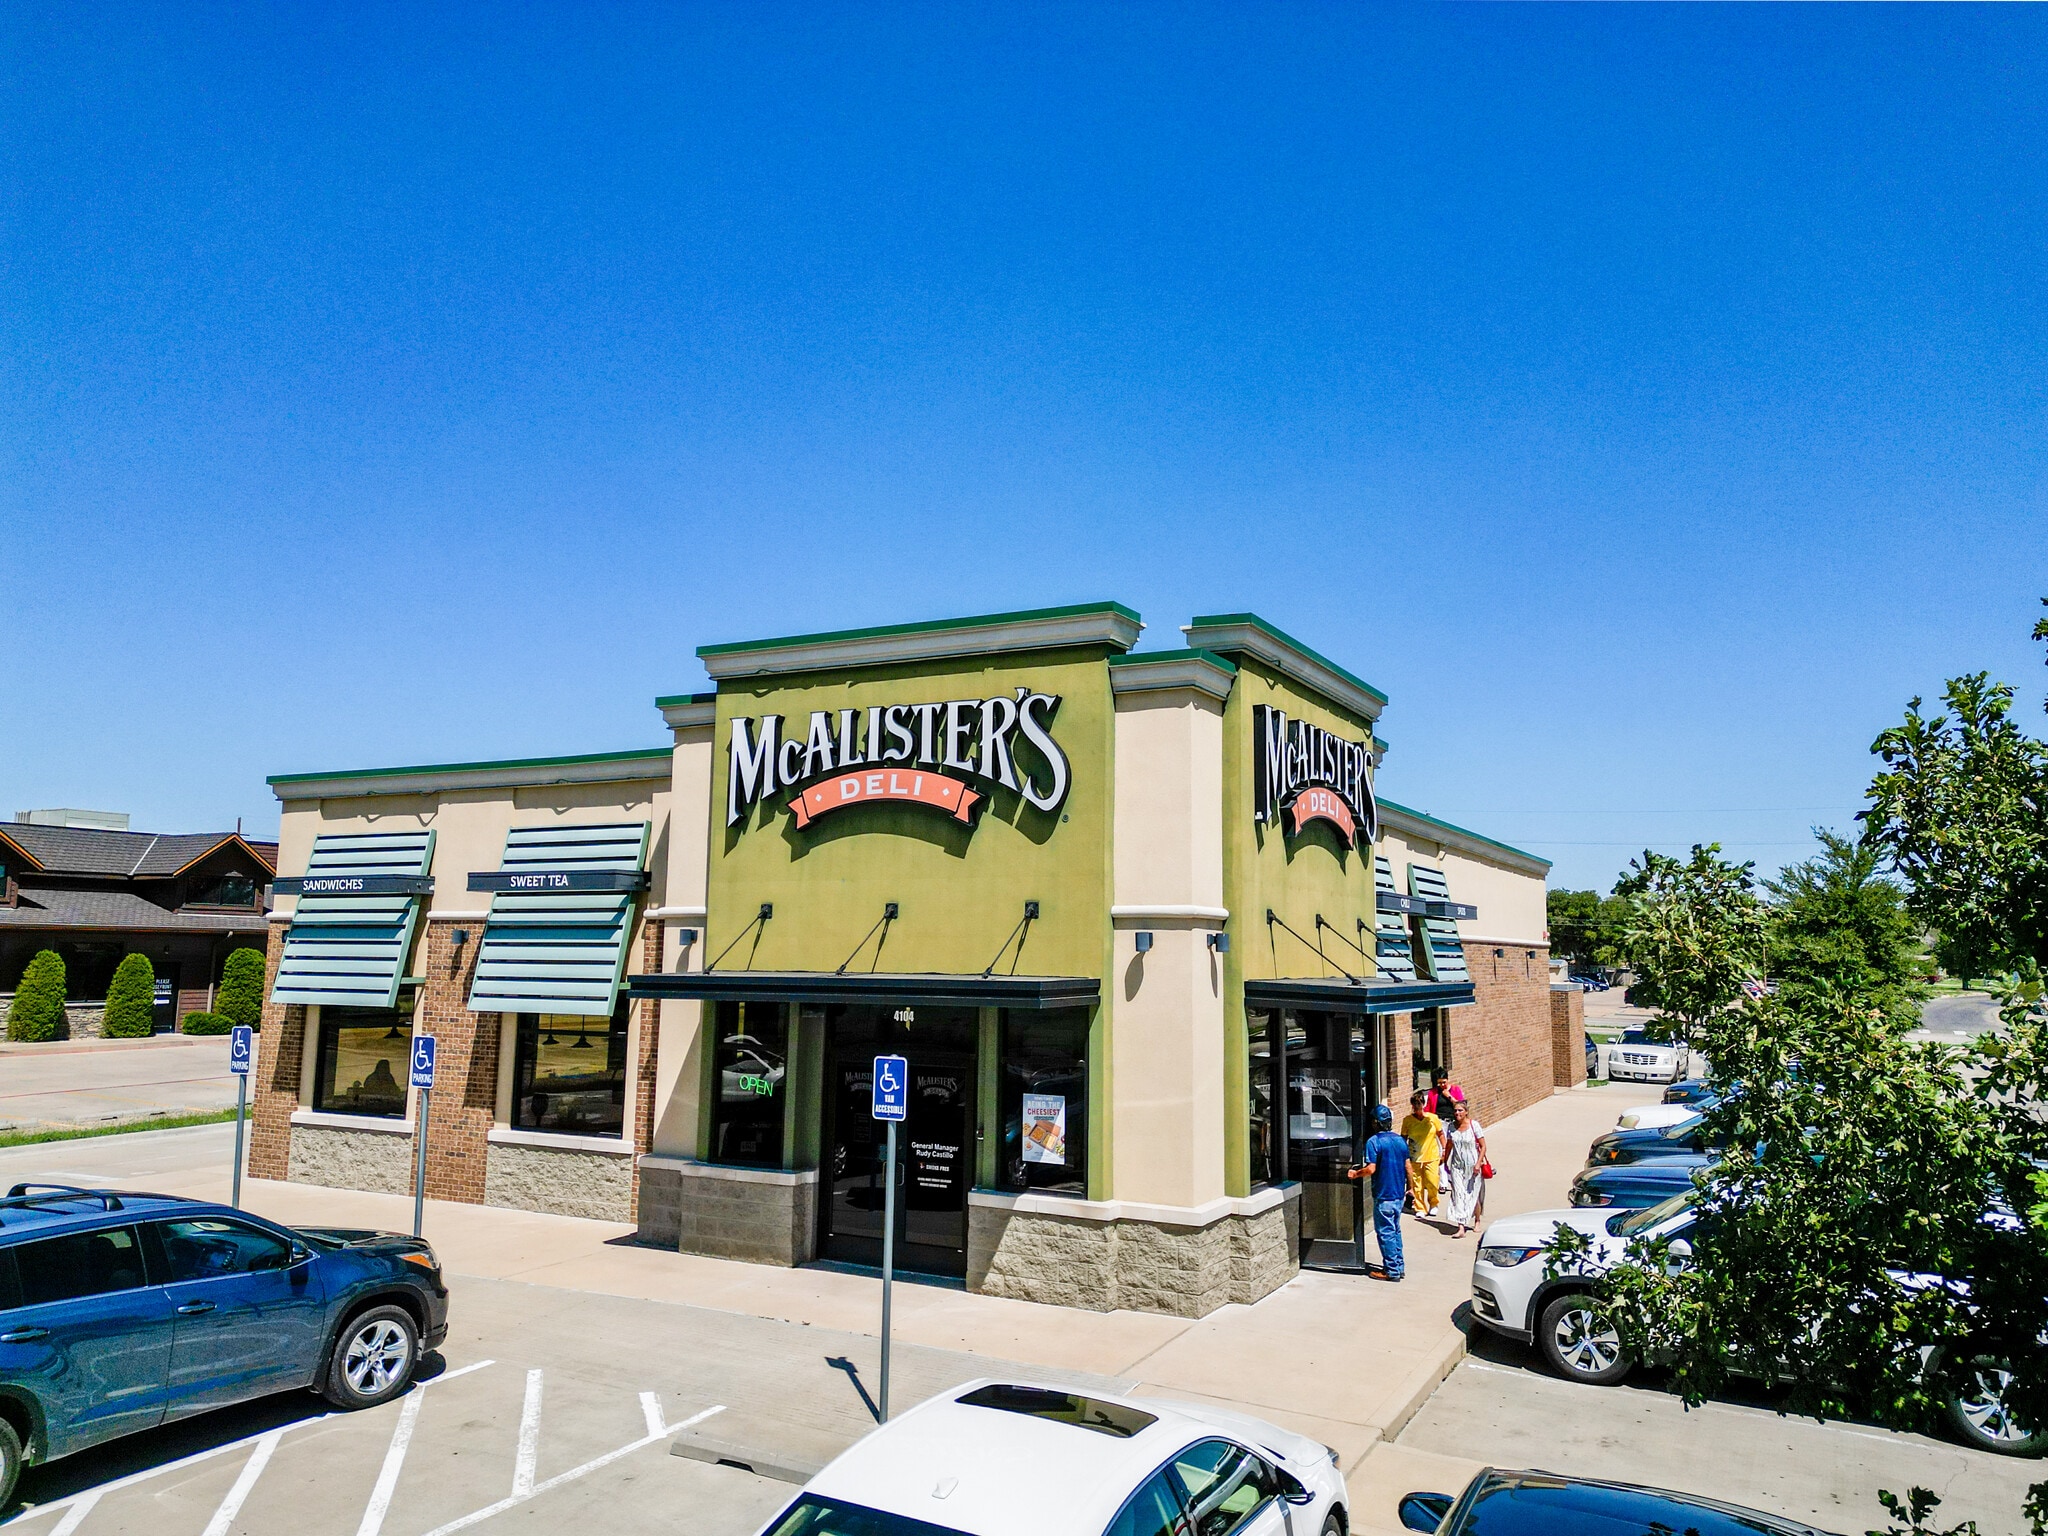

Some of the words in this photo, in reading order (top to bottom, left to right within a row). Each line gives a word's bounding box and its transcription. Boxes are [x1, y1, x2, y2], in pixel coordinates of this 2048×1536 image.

[840, 773, 923, 800] DELI
[1311, 792, 1340, 819] DELI
[303, 878, 364, 891] SANDWICHES
[510, 875, 546, 888] SWEET
[548, 874, 569, 887] TEA
[893, 1010, 915, 1022] 4104
[231, 1061, 249, 1071] PARKING
[412, 1072, 432, 1083] PARKING
[739, 1074, 774, 1097] OPEN
[884, 1094, 895, 1103] VAN
[875, 1104, 904, 1115] ACCESSIBLE
[1027, 1108, 1061, 1116] CHEESIEST
[911, 1141, 934, 1150] General
[934, 1143, 959, 1153] Manager
[916, 1149, 931, 1158] Rudy
[932, 1150, 954, 1159] Castillo
